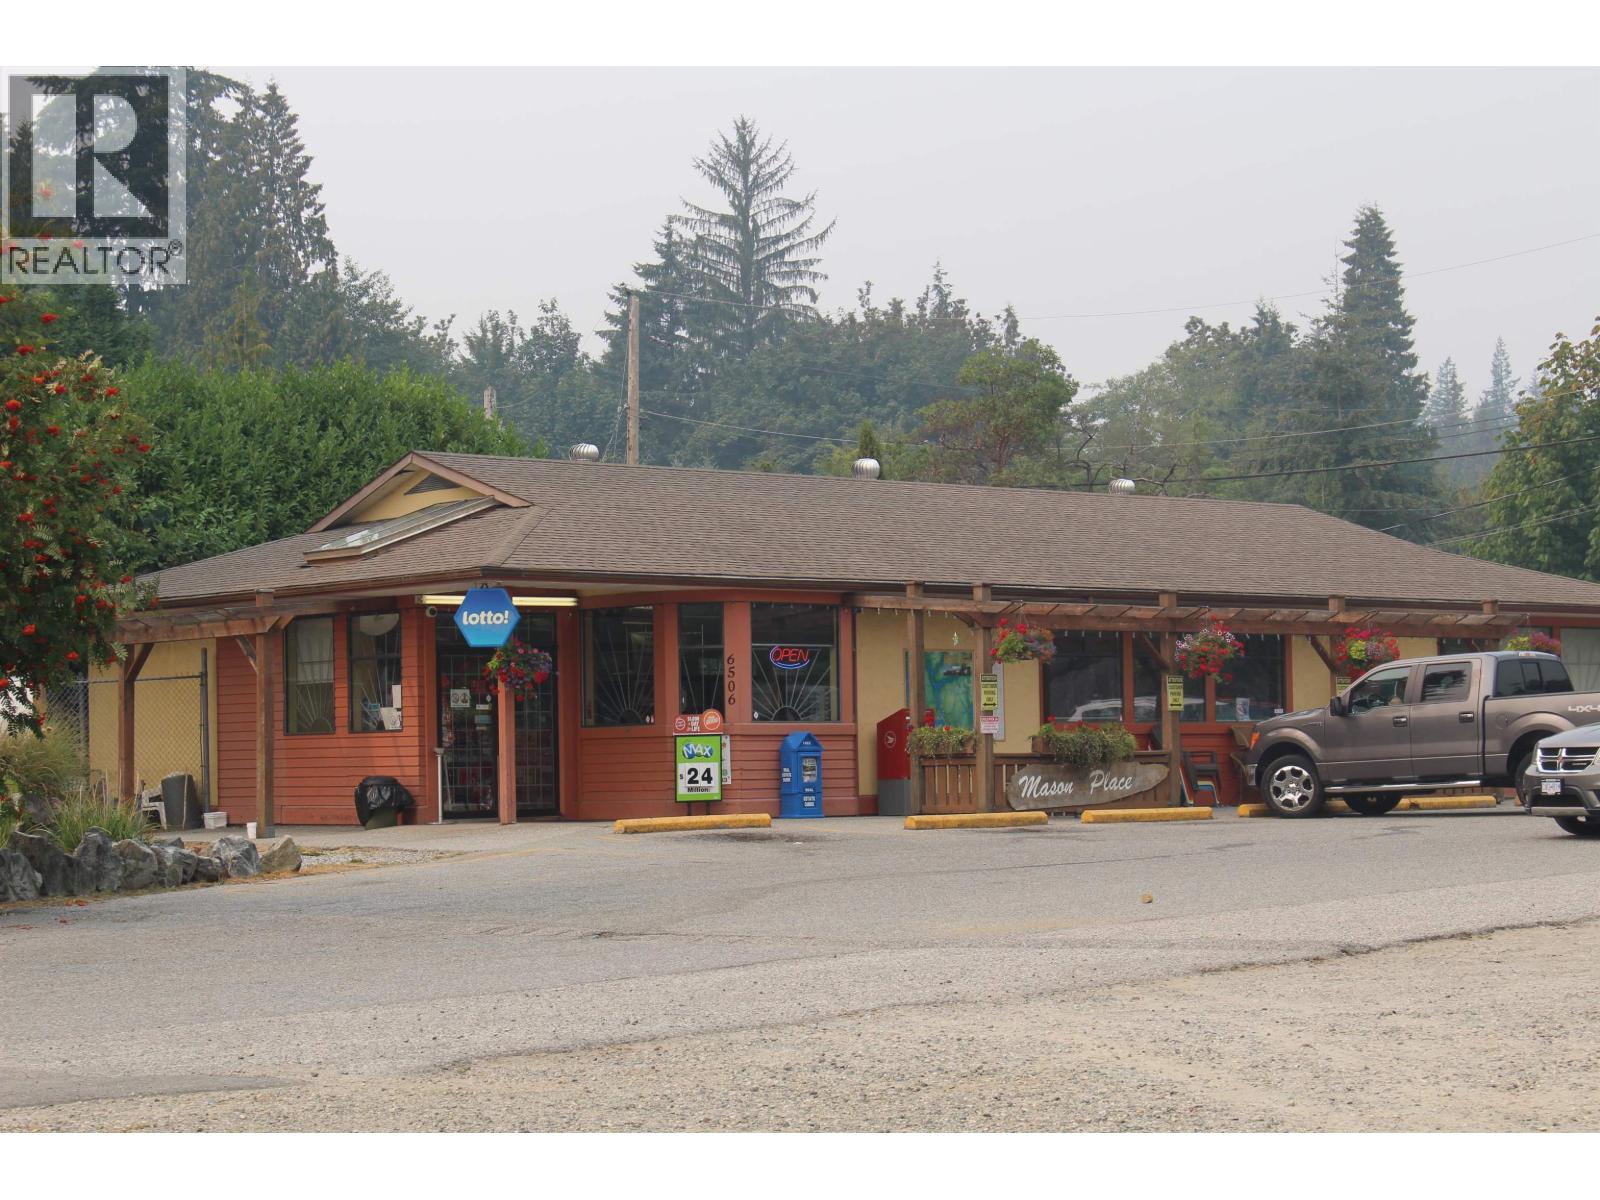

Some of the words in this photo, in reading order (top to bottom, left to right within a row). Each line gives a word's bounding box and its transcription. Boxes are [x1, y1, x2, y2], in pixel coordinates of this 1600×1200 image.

[462, 610, 509, 625] lotto!
[772, 648, 809, 662] OPEN
[727, 653, 736, 706] 6506
[682, 743, 713, 758] MAX
[687, 767, 713, 785] 24
[1018, 775, 1074, 798] Mason
[1089, 769, 1132, 795] Place
